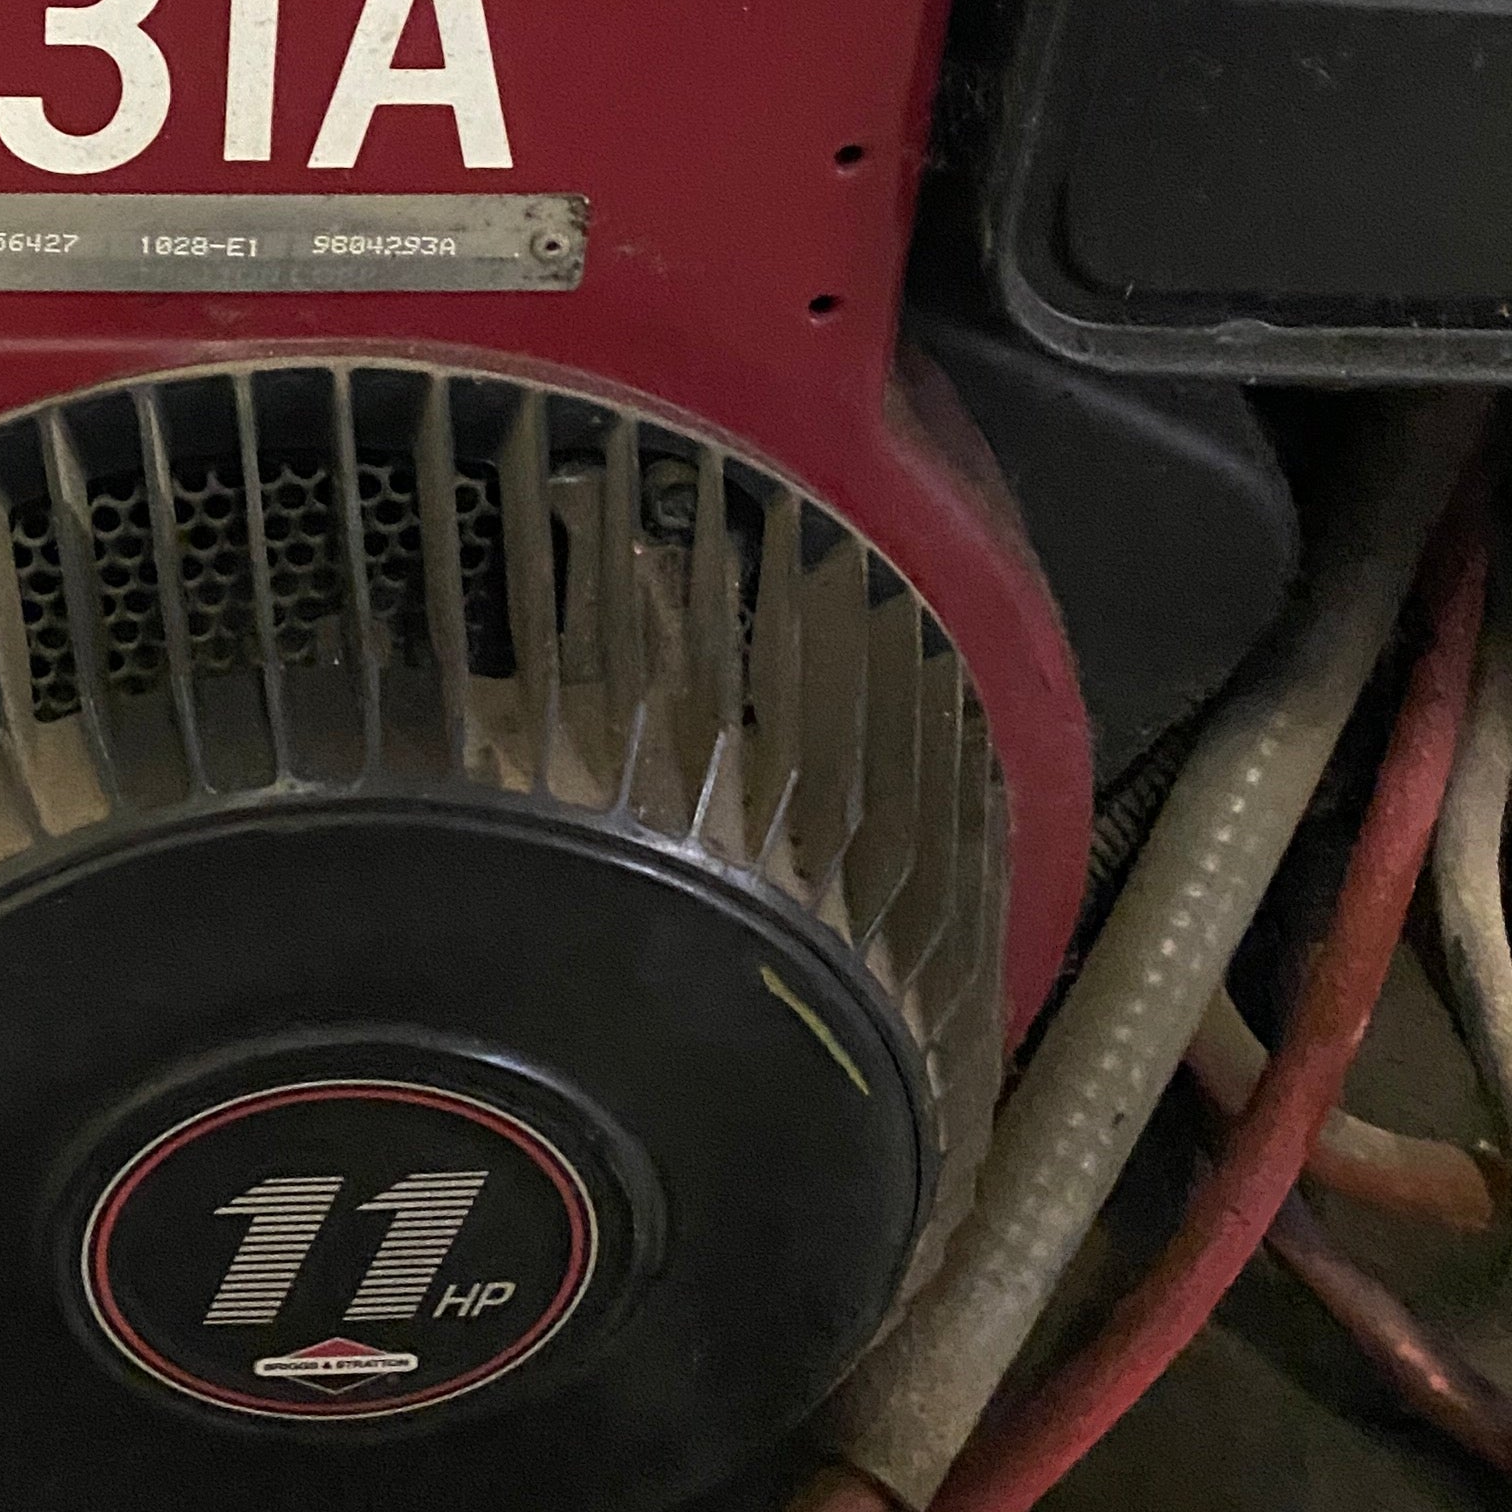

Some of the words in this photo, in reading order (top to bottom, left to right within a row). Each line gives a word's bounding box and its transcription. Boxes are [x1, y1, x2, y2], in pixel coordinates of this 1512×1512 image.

[141, 235, 258, 257] 1028-E1
[202, 1170, 489, 1325] 11
[433, 1281, 516, 1319] HP
